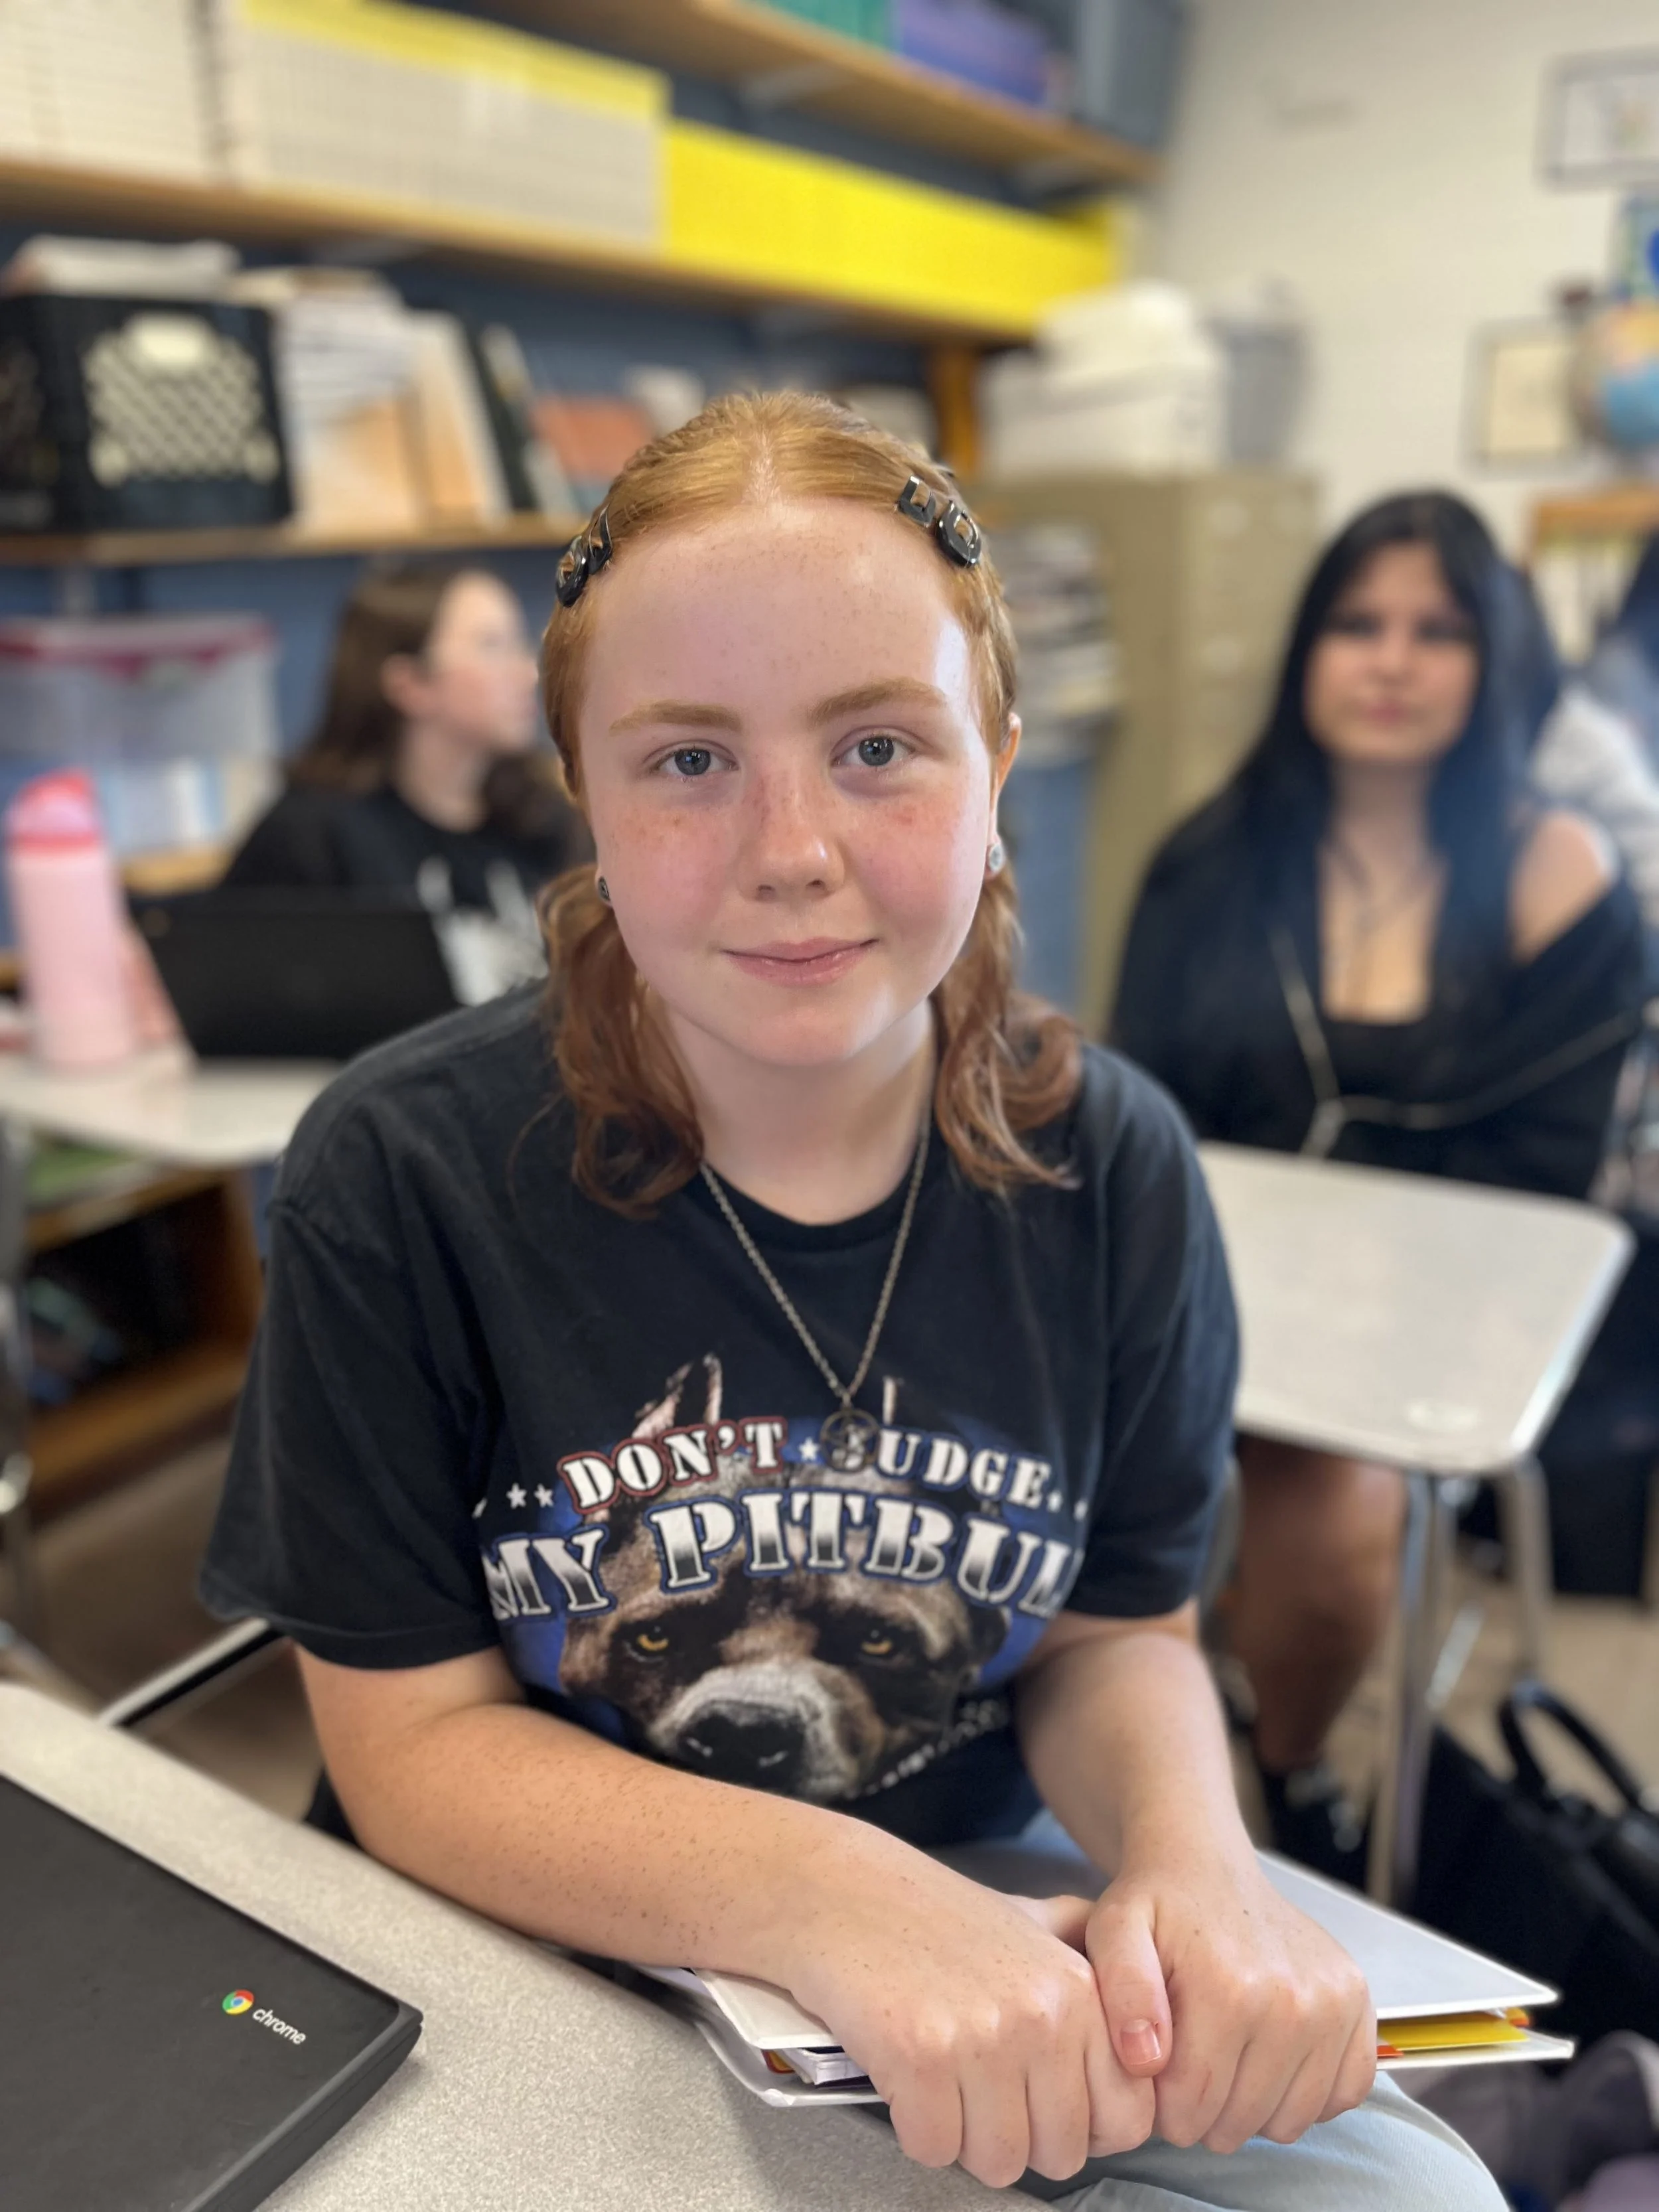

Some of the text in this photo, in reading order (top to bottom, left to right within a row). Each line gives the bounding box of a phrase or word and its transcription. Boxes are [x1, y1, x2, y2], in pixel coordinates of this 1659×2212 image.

[559, 1421, 785, 1510] DON'T
[482, 1491, 1085, 1620] MY PITBUL
[252, 2008, 307, 2045] chrome
